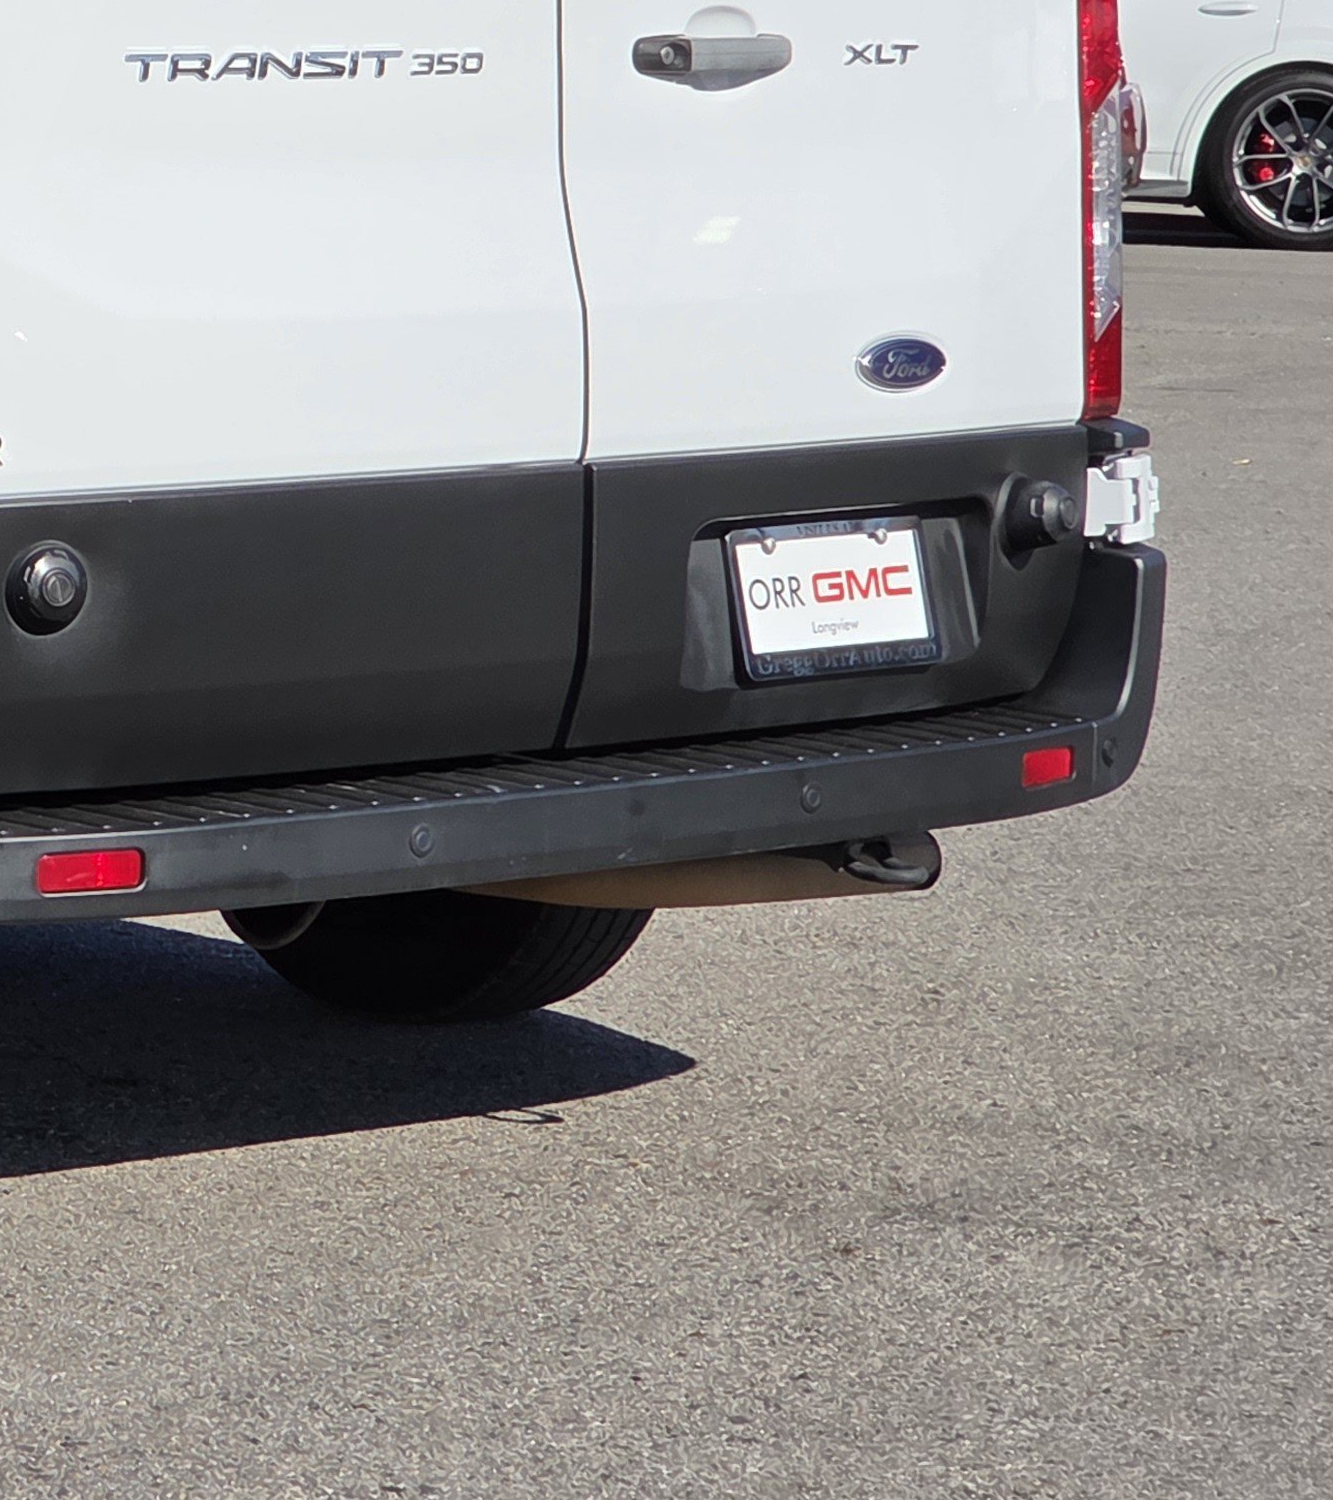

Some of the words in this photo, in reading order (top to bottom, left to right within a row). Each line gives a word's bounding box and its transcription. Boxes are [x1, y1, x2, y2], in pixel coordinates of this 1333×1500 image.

[123, 48, 403, 83] TRANSIT
[409, 51, 485, 77] 350
[843, 43, 921, 66] XLT
[881, 347, 932, 380] Ford
[748, 575, 806, 611] ORR
[811, 564, 913, 604] GMC
[811, 617, 860, 637] Longview
